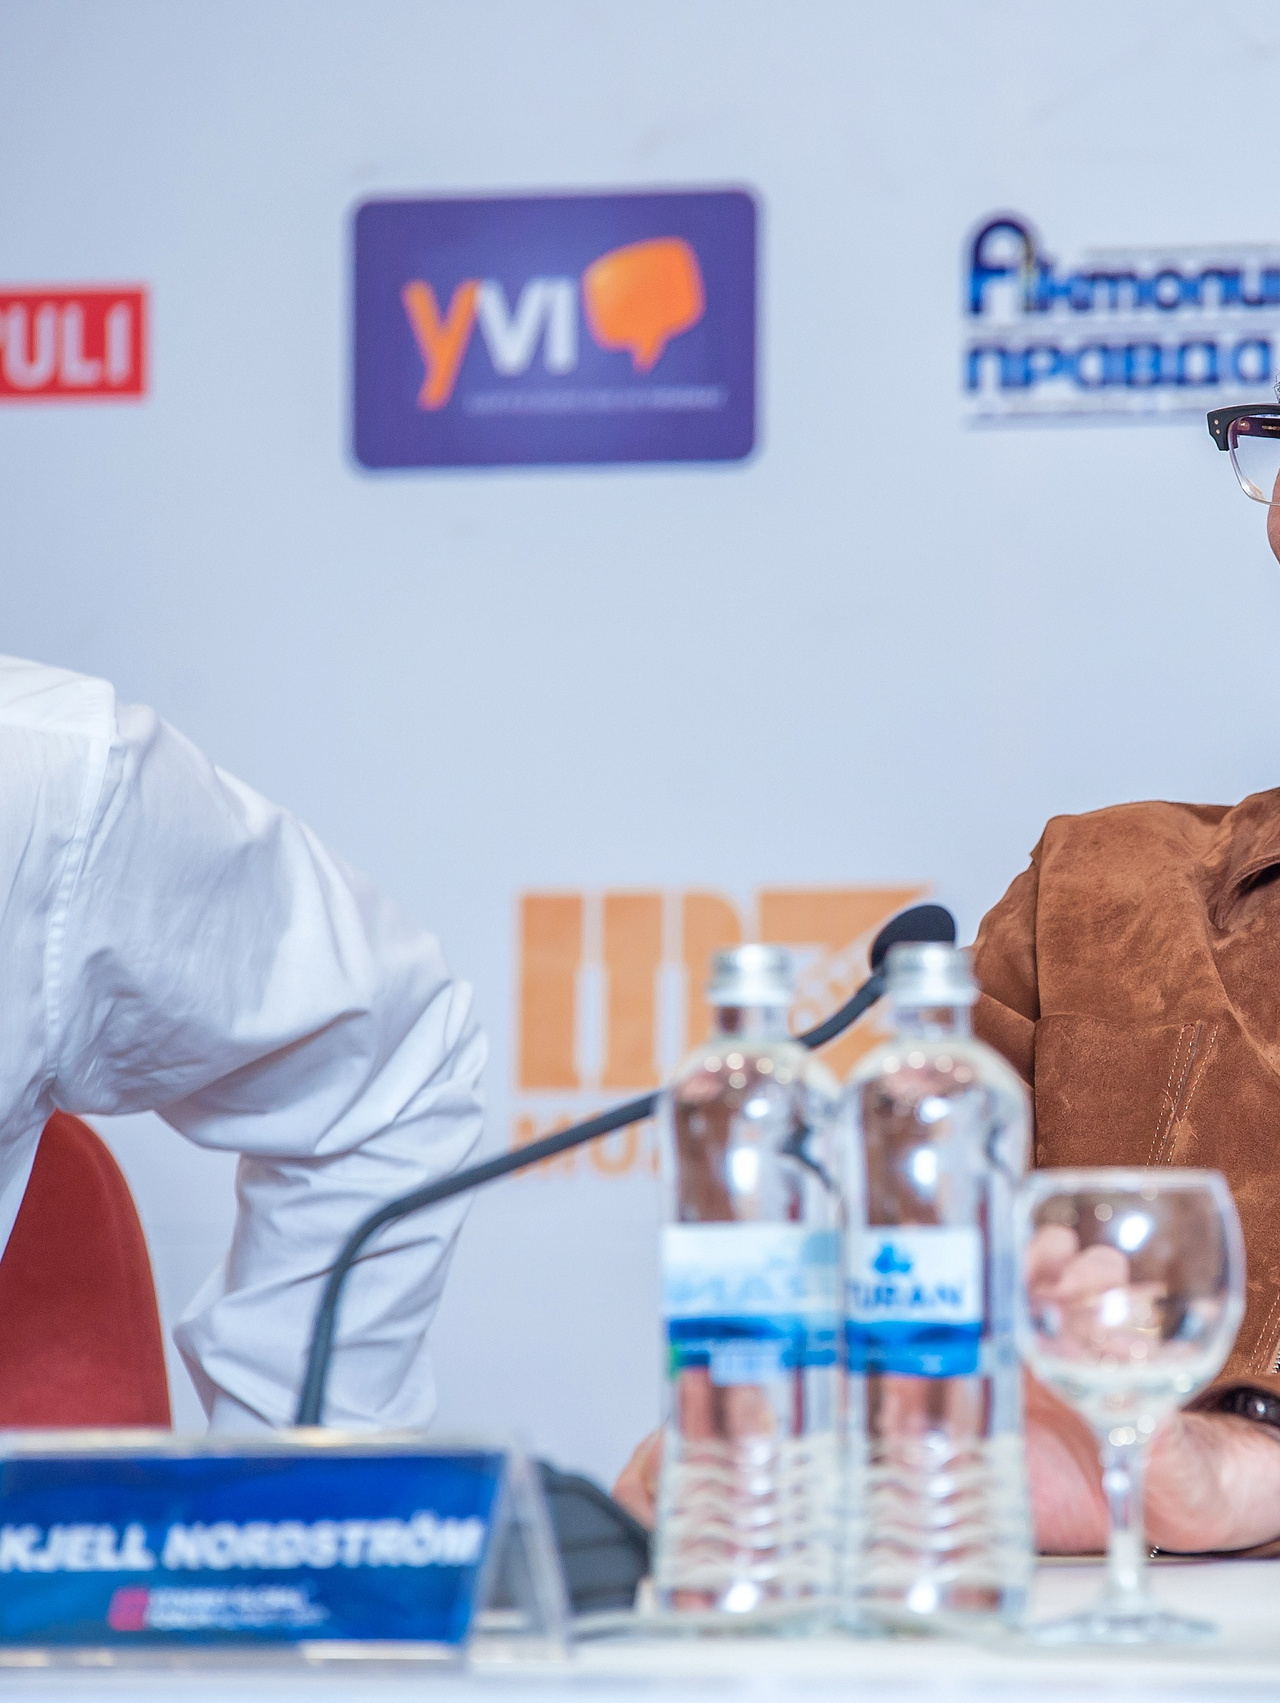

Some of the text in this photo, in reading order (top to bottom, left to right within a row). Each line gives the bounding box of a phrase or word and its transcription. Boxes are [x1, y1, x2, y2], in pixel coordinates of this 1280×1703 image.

[0, 301, 131, 388] ULI
[0, 1510, 485, 1572] KJELL NORDSTRÖM
